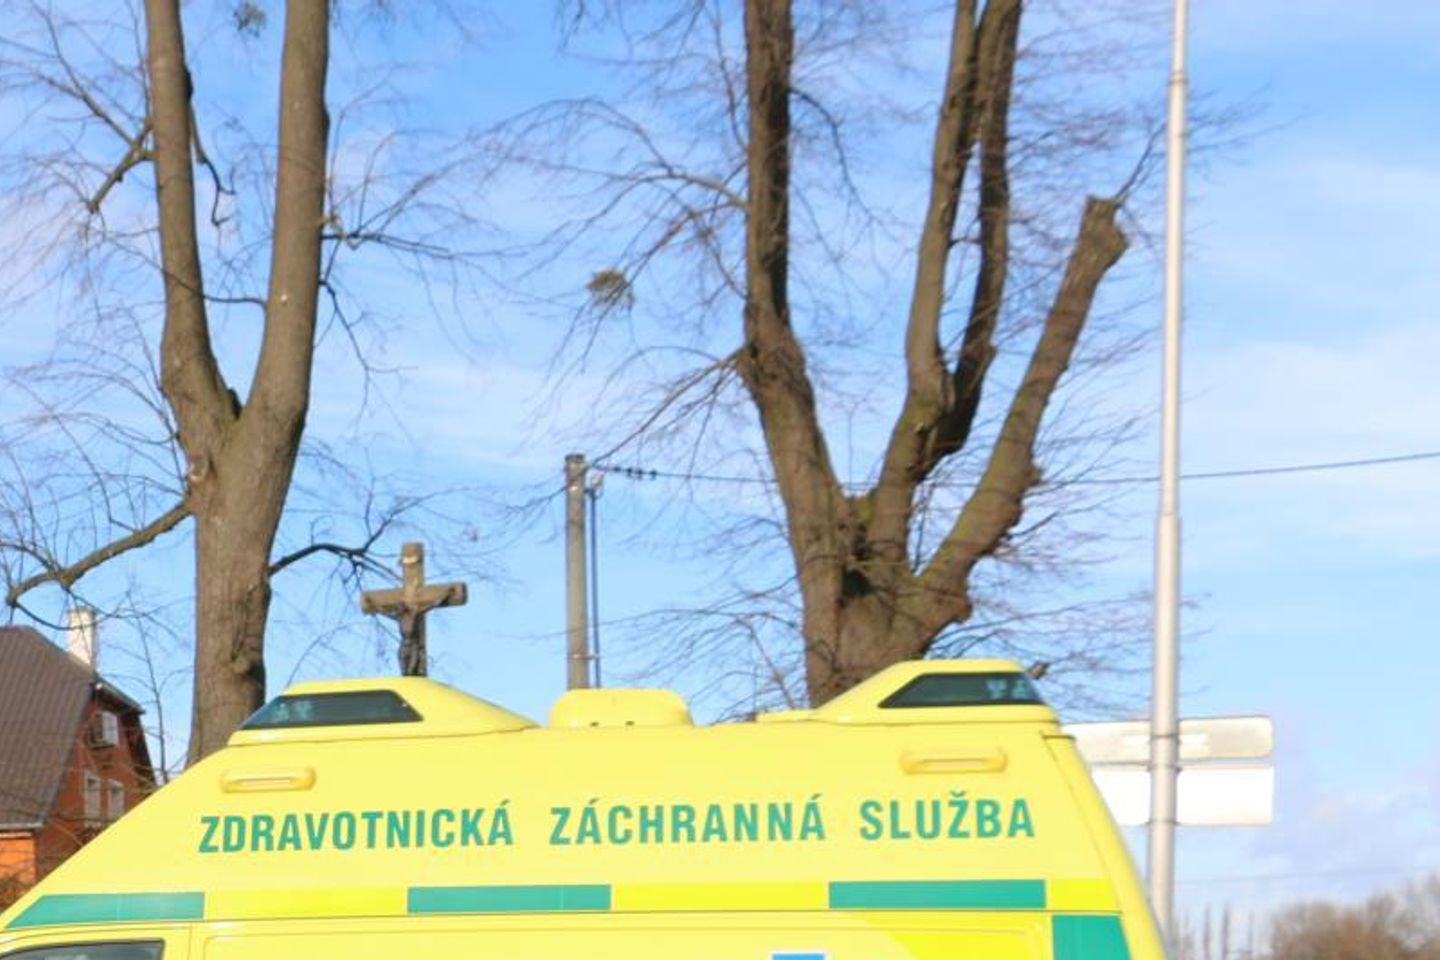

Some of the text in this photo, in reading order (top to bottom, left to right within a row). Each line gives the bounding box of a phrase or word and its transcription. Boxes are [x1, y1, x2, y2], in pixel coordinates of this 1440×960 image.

[198, 789, 1036, 853] ZDRAVOTNICKÁ ZÁCHRANNÁ SLUŽBA
